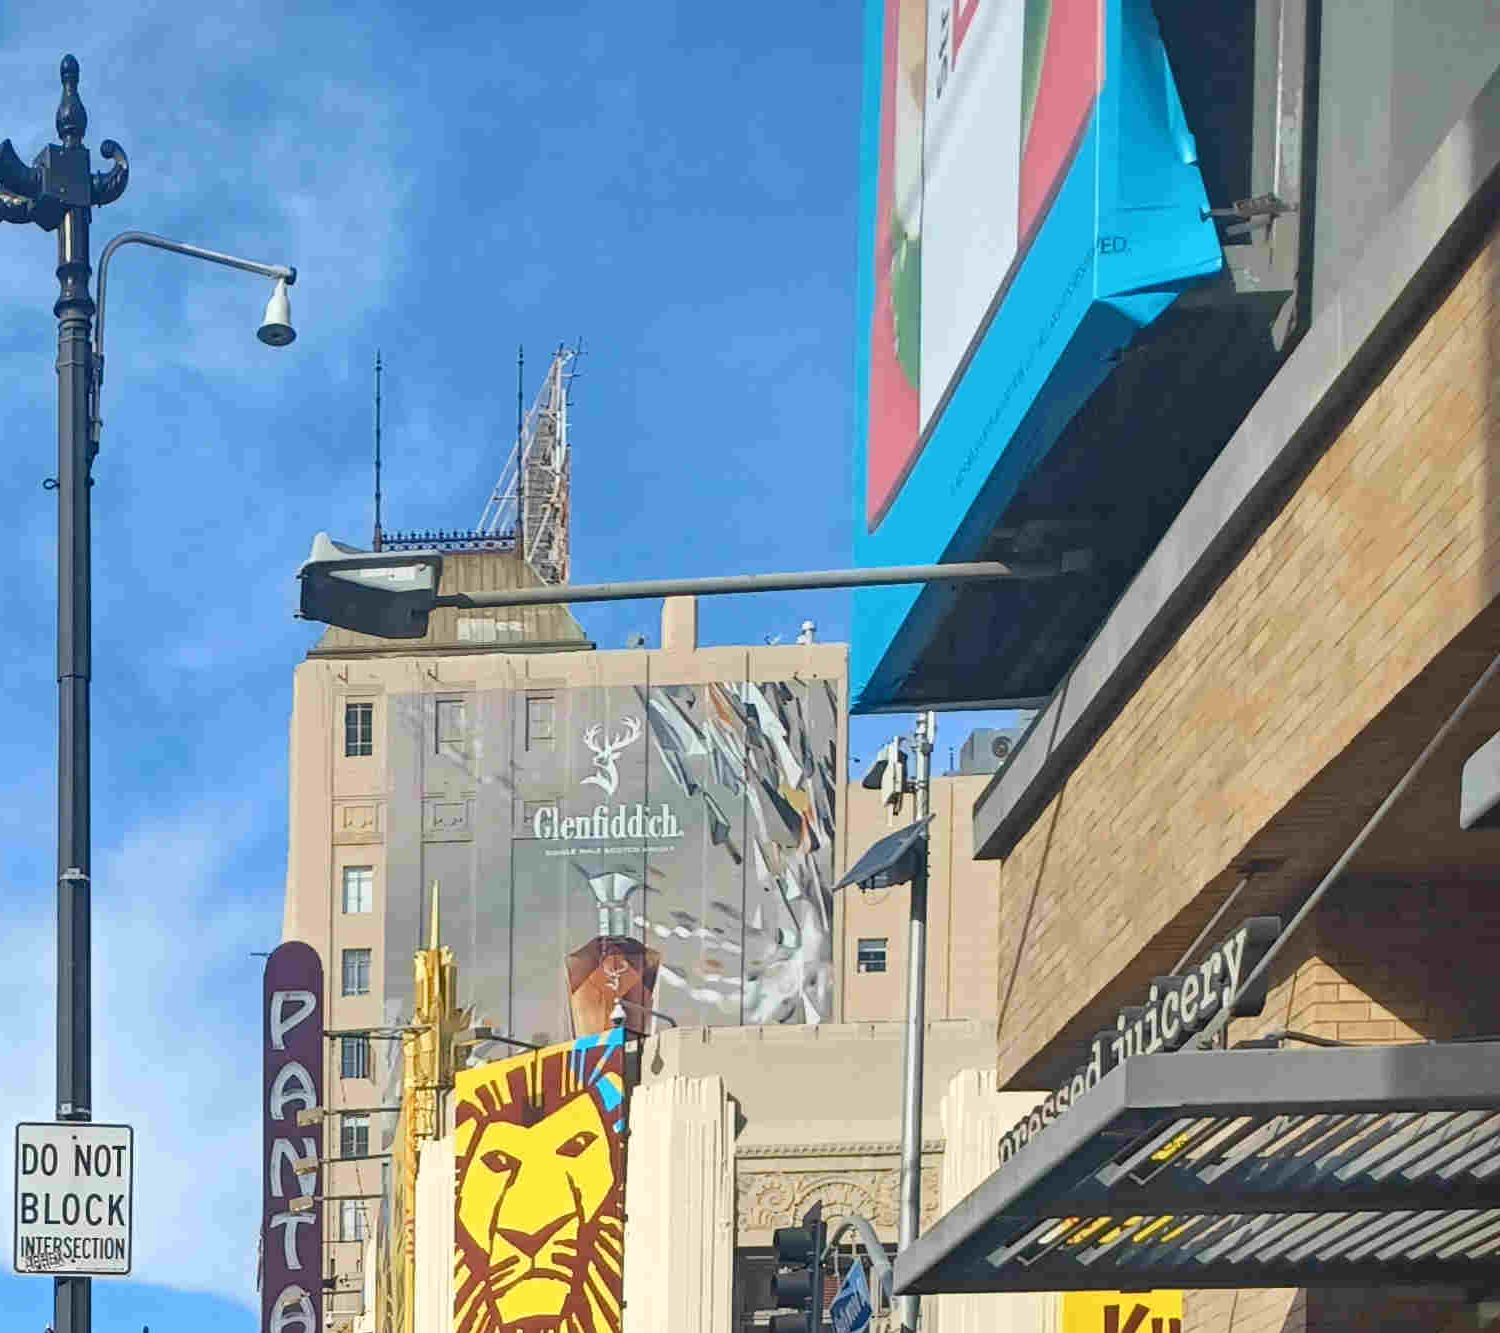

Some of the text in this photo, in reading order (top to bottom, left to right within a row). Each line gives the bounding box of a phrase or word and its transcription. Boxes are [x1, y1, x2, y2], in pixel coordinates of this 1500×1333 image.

[1111, 928, 1248, 1063] juicery
[21, 1143, 126, 1177] DO NOT
[20, 1192, 125, 1226] BLOCK
[20, 1236, 125, 1259] INTERSECTION
